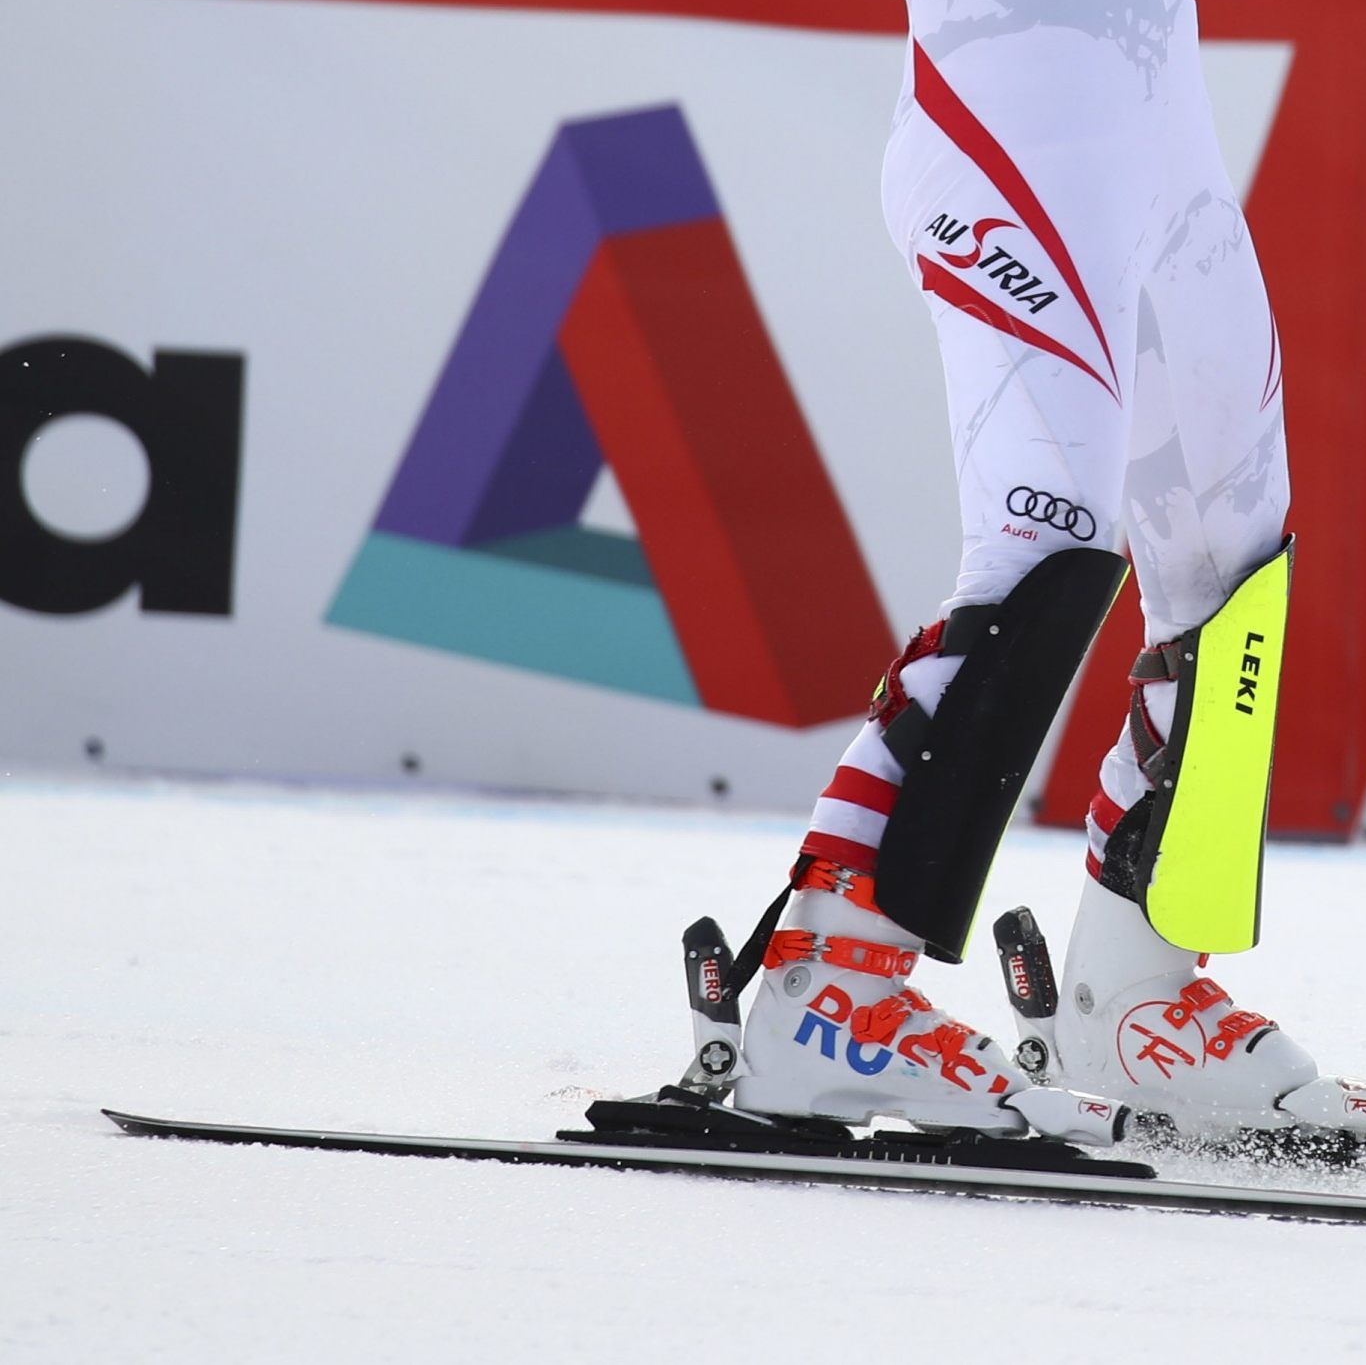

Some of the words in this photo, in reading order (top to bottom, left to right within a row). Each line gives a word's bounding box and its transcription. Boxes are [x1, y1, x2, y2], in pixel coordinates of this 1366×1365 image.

[924, 213, 1059, 314] AUSTRIA
[1001, 523, 1039, 542] Audi
[1235, 631, 1264, 716] LEKI
[701, 958, 721, 1004] HERO
[1007, 955, 1031, 999] HERO
